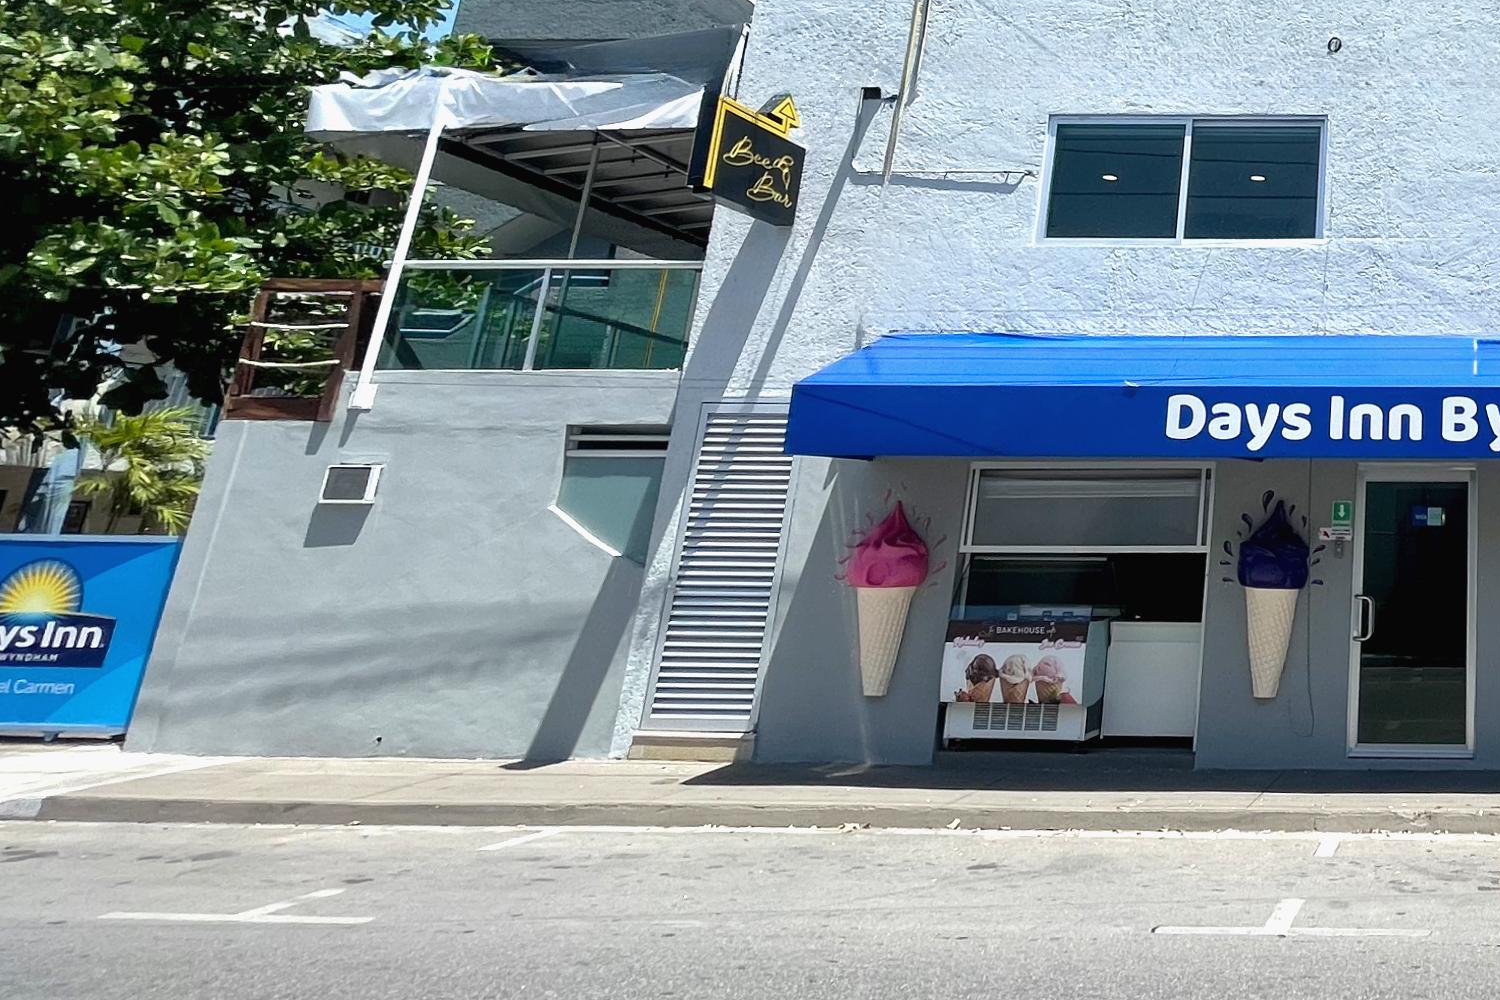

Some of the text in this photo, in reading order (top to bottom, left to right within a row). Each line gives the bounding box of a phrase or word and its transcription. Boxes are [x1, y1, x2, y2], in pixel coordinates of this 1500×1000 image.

[746, 171, 793, 208] Bar
[1165, 393, 1312, 451] Days
[1329, 394, 1423, 442] Inn
[40, 621, 103, 649] Inn
[996, 626, 1045, 635] BAKEHOUSE
[13, 679, 76, 694] Carmen
